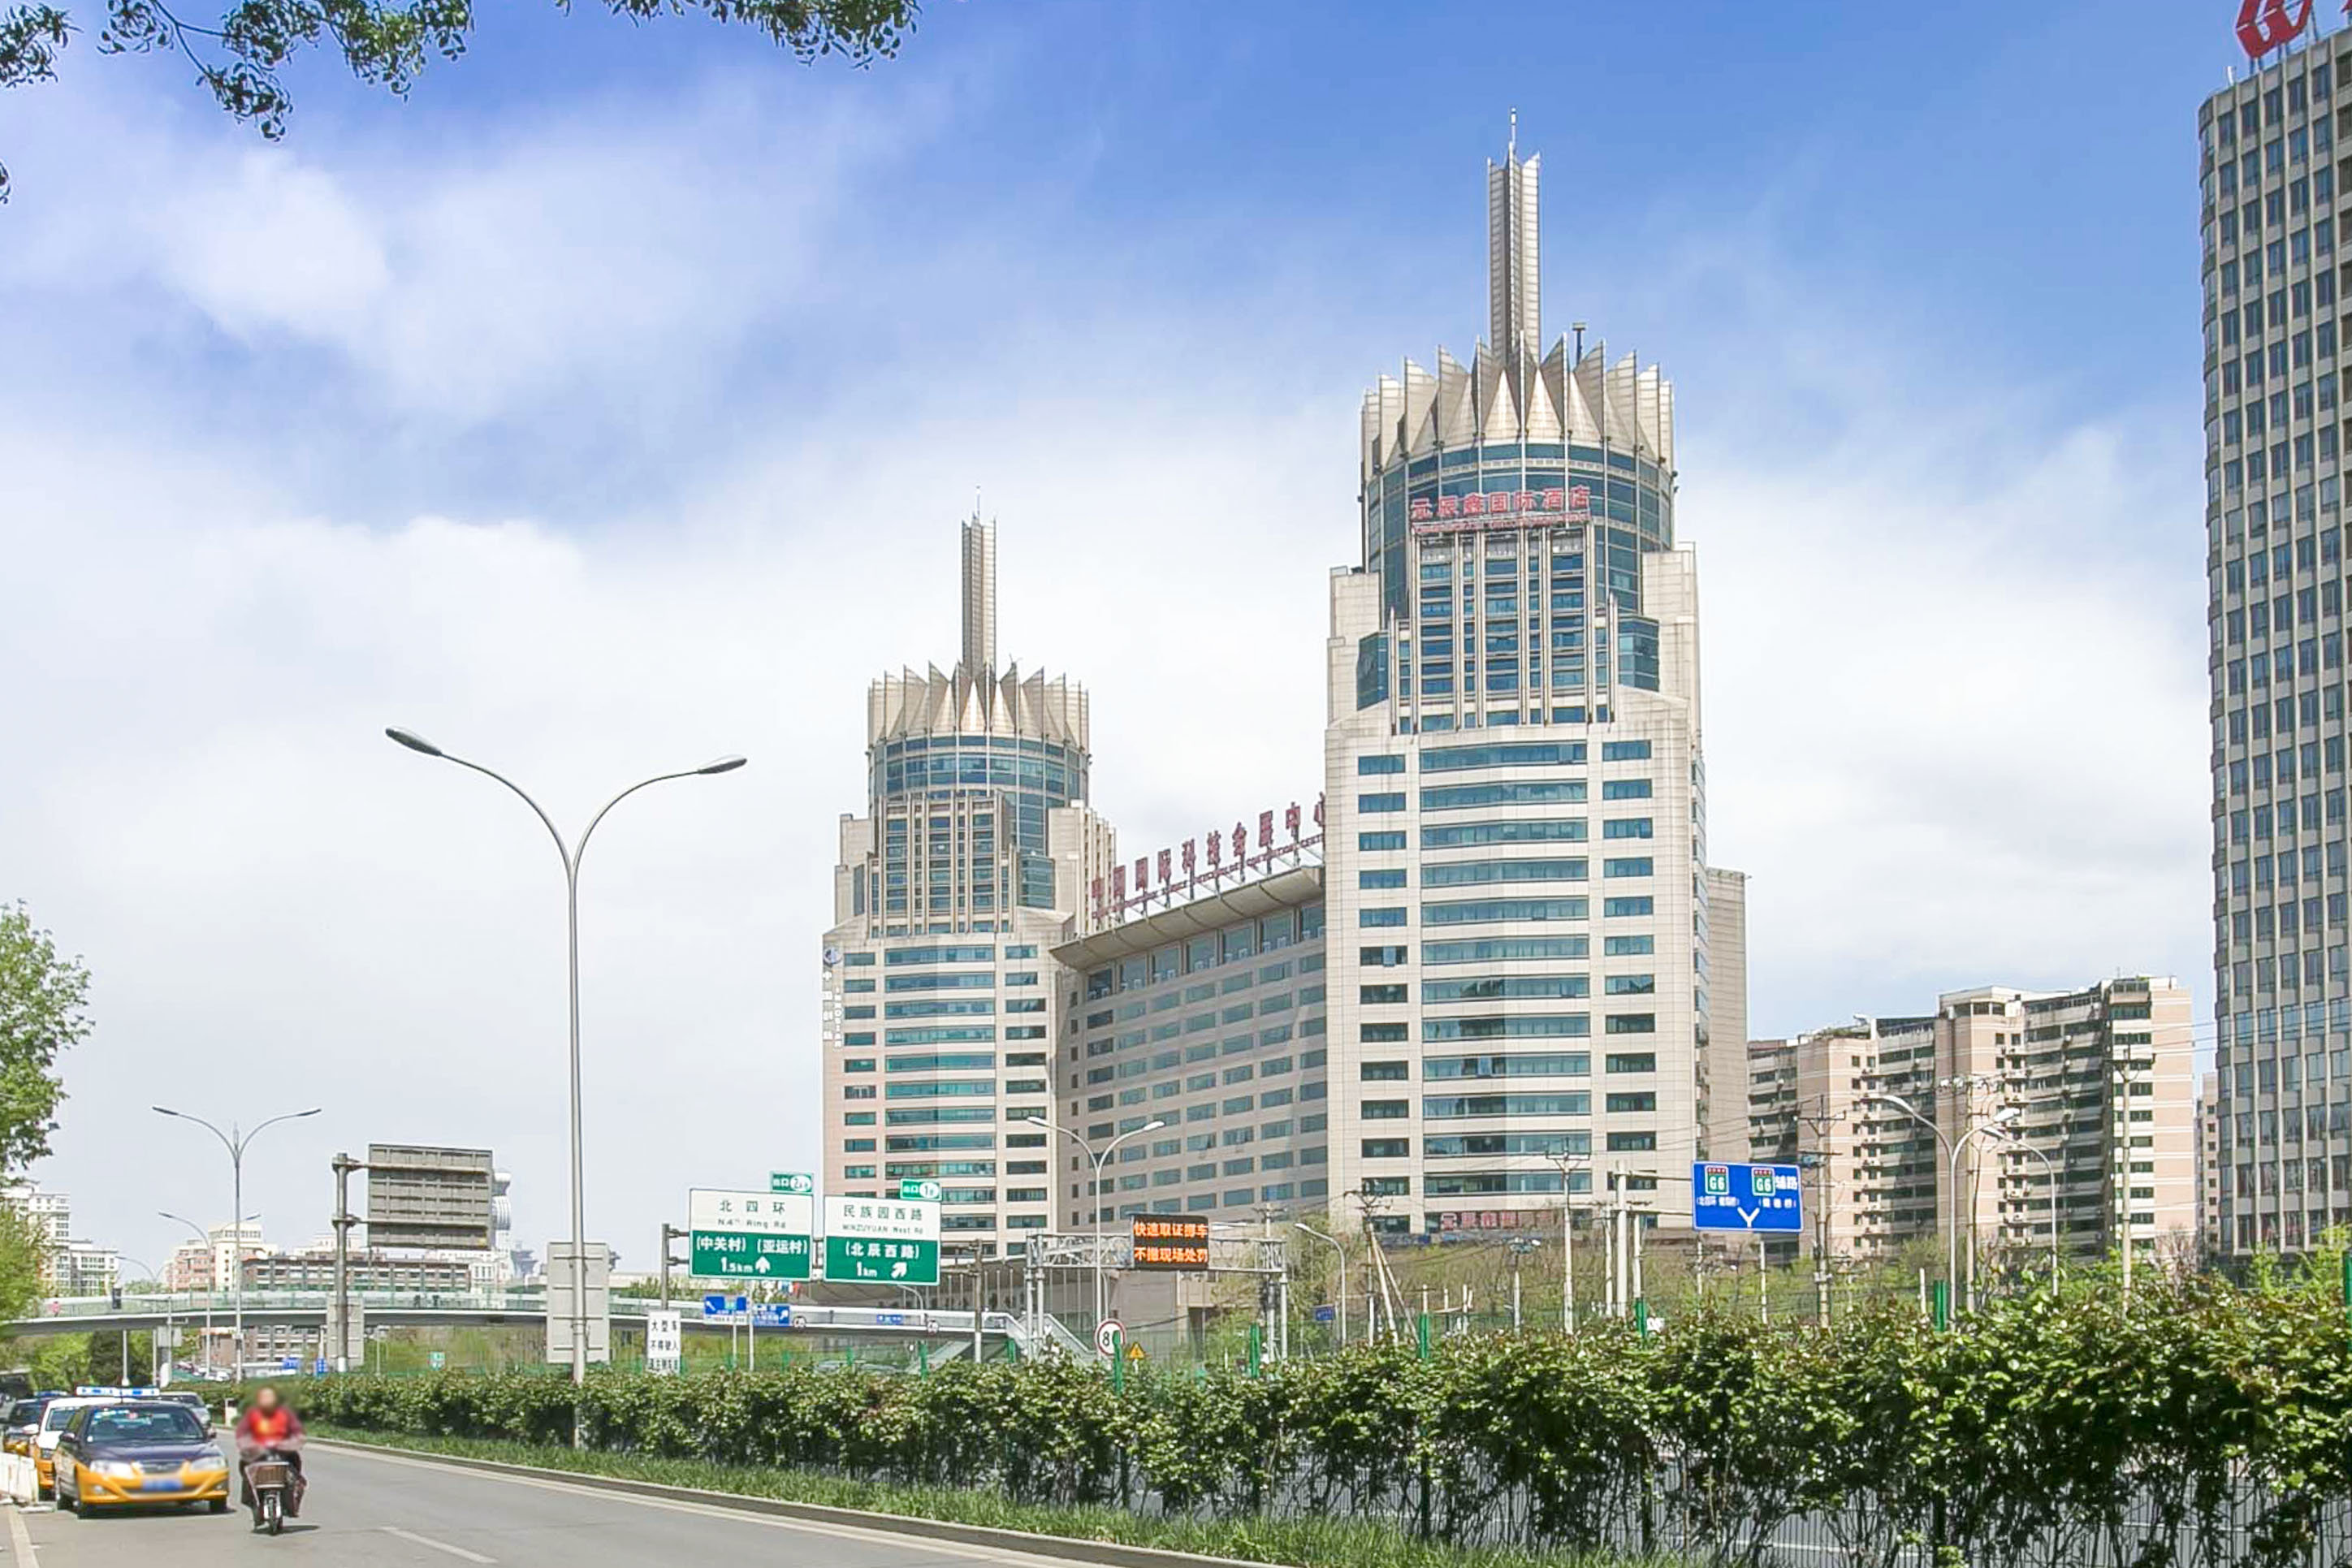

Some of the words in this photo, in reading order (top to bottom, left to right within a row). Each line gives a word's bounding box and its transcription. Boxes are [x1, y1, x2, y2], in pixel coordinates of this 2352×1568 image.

[1411, 485, 1590, 520] 元辰鑫国际酒店
[1709, 1176, 1726, 1190] G6
[1756, 1178, 1772, 1192] G6
[720, 1200, 785, 1214] 北四环
[844, 1205, 922, 1220] 民族园西路
[746, 1220, 768, 1229] Ring
[774, 1220, 786, 1229] Rd
[651, 1320, 677, 1332] 大型车
